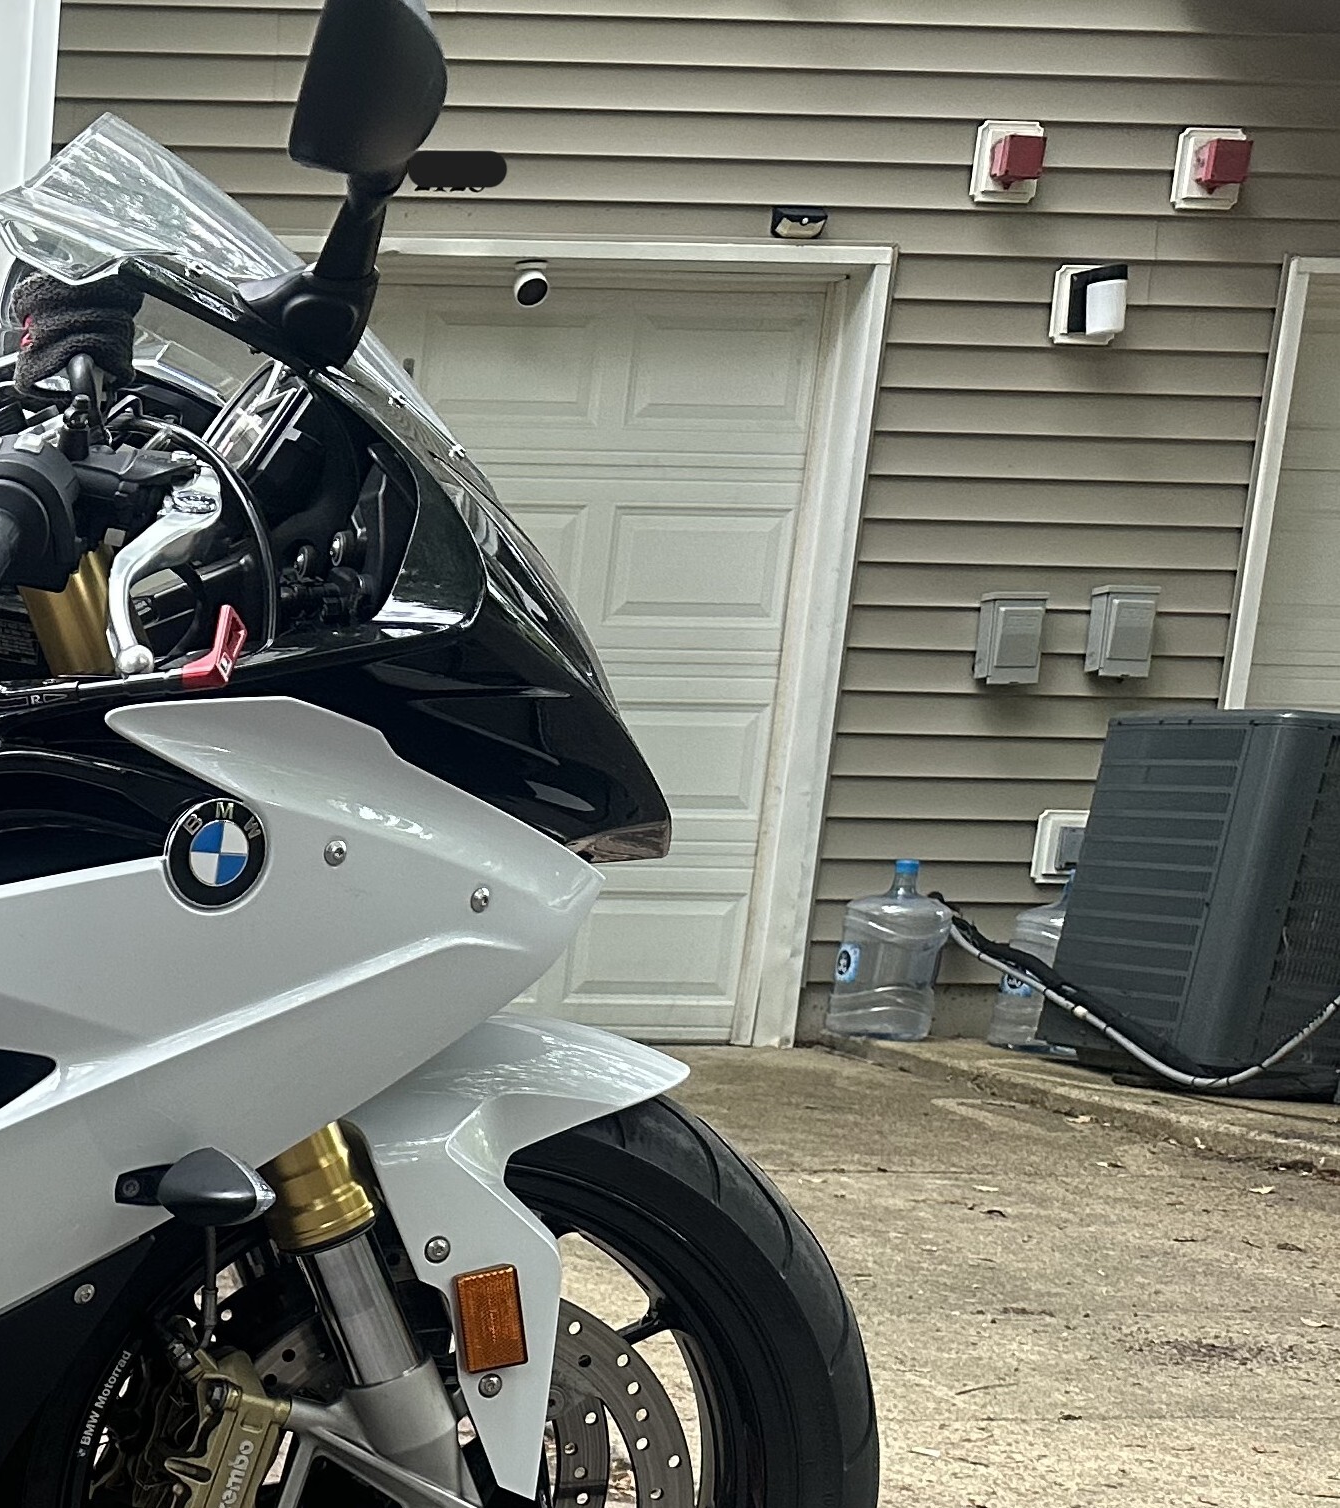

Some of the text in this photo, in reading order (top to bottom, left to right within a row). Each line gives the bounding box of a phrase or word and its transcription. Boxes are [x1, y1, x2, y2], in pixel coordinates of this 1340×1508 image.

[182, 801, 262, 840] BMW
[80, 1350, 132, 1446] BMW Motorrad
